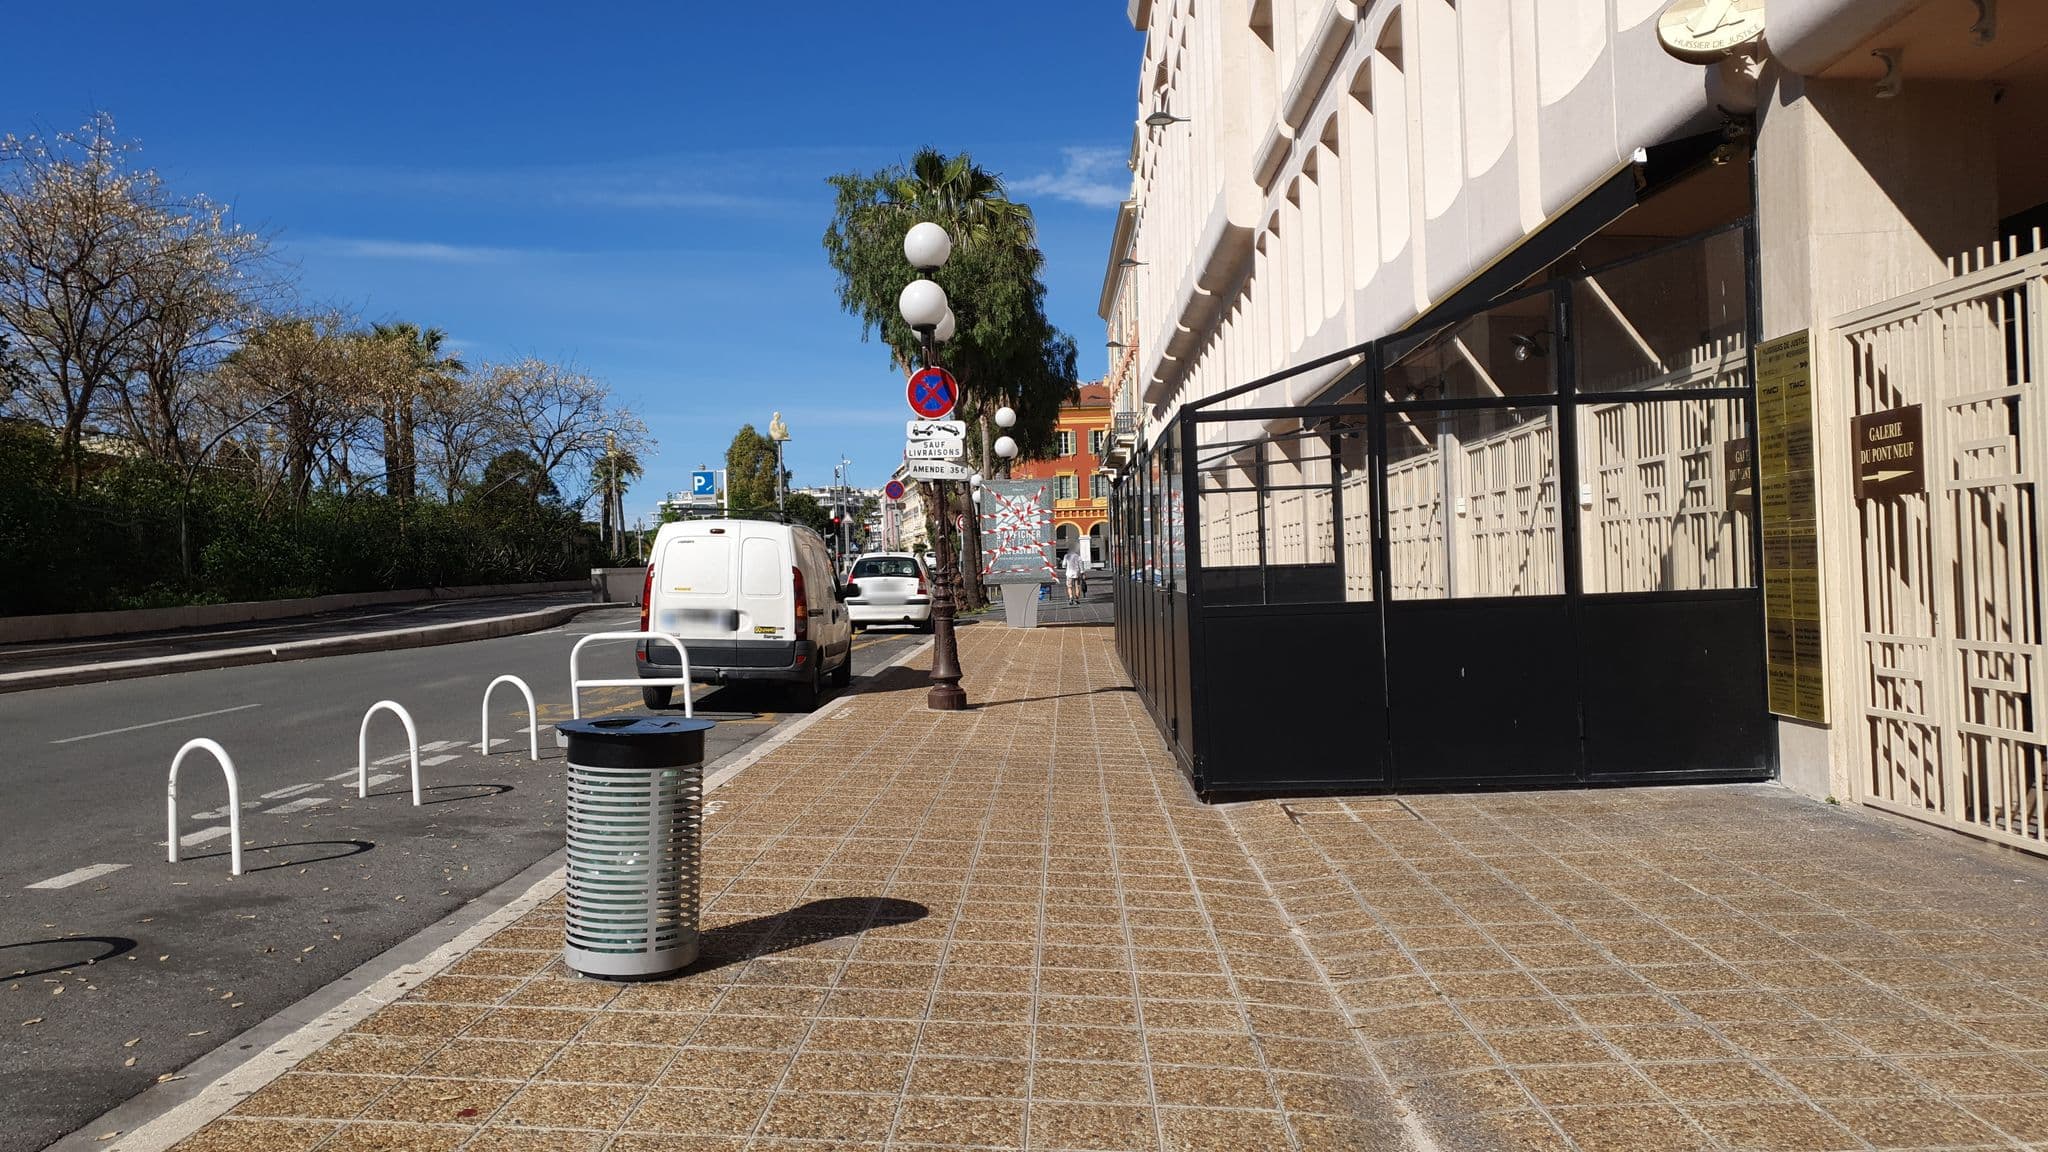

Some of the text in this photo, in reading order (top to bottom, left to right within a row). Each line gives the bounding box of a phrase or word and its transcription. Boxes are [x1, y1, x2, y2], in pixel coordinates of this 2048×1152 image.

[1674, 23, 1762, 49] HUISSIER DE JUSTICE
[1869, 422, 1903, 442] GALERIE
[923, 441, 946, 449] SAUF
[908, 448, 960, 457] LIVRAISONS
[1860, 441, 1915, 464] DU PONT NEUF
[912, 465, 965, 474] AMENDE 35€
